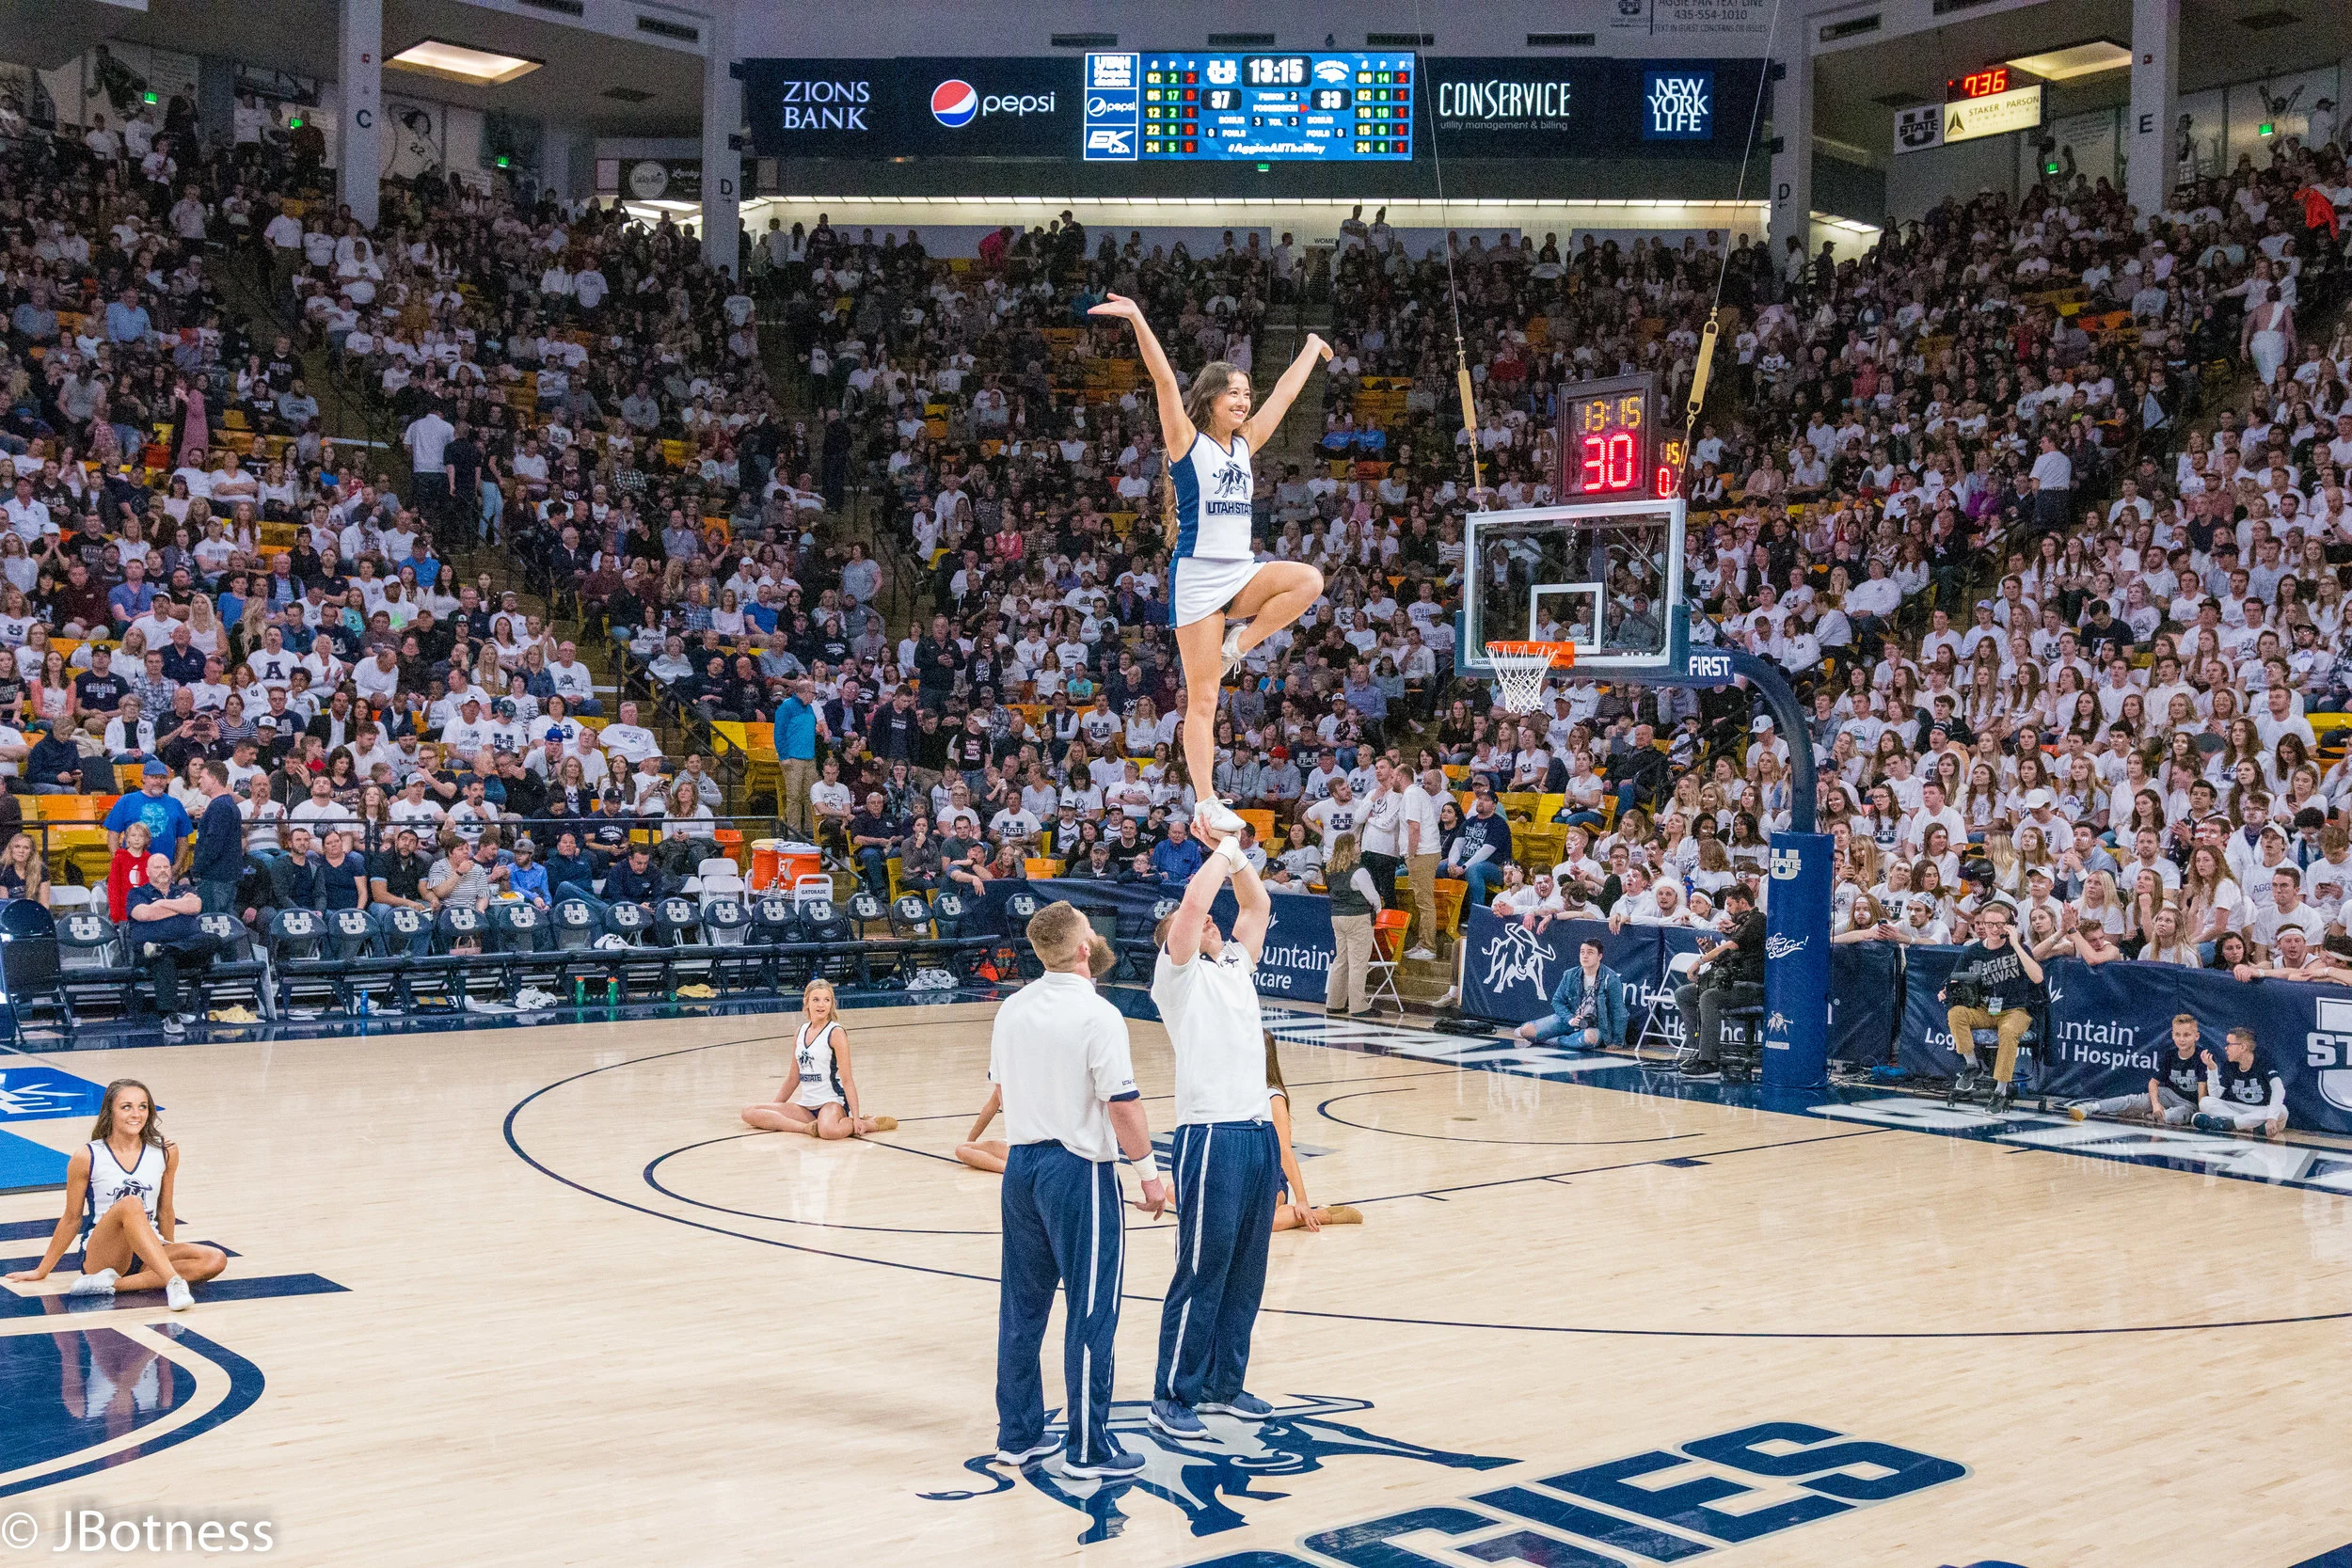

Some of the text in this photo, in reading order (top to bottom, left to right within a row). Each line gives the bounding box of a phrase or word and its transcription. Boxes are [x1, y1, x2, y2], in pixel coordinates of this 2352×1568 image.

[1675, 9, 1747, 20] 435-554-1010
[1169, 60, 1176, 70] P
[1249, 58, 1304, 83] 13:15
[1169, 72, 1177, 84] 2
[1186, 72, 1195, 84] 2
[1376, 72, 1391, 84] 14
[1397, 72, 1406, 84] 2
[783, 80, 870, 103] ZIONS
[1167, 89, 1180, 101] 17
[1399, 89, 1406, 101] 1
[1656, 78, 1704, 96] NEW
[982, 91, 1056, 117] pepsi
[1211, 90, 1232, 109] 37
[1290, 91, 1297, 101] 2
[1320, 90, 1342, 109] 33
[1106, 101, 1136, 112] pepsi
[1147, 107, 1193, 119] 12 2 1
[1399, 107, 1406, 119] 1
[1647, 96, 1708, 115] YORK
[1968, 96, 2040, 117] STAKER PARSON
[356, 109, 372, 128] C
[783, 106, 868, 131] BANK
[1254, 117, 1262, 126] 3
[1291, 117, 1298, 126] 3
[1465, 121, 1528, 131] management
[1539, 120, 1568, 131] billing
[1655, 113, 1702, 132] LIFE
[2139, 114, 2153, 134] E
[1146, 124, 1161, 135] 22
[1336, 128, 1343, 137] 0
[1358, 124, 1371, 135] 15
[1398, 124, 1405, 135] 1
[1899, 119, 1939, 137] STATE
[1146, 142, 1160, 153] 24
[1168, 142, 1176, 153] 5
[1357, 142, 1405, 153] 24 4 1
[721, 178, 733, 196] D
[1778, 182, 1790, 199] D
[1585, 396, 1641, 431] 13:15
[1584, 433, 1633, 491] 30
[1206, 500, 1234, 515] UTAH
[263, 660, 286, 680] A
[1689, 656, 1732, 677] FIRST
[599, 824, 623, 834] NEVADA
[999, 826, 1025, 834] STATE
[1991, 964, 2021, 985] WAY
[2074, 1044, 2159, 1070] Hospital
